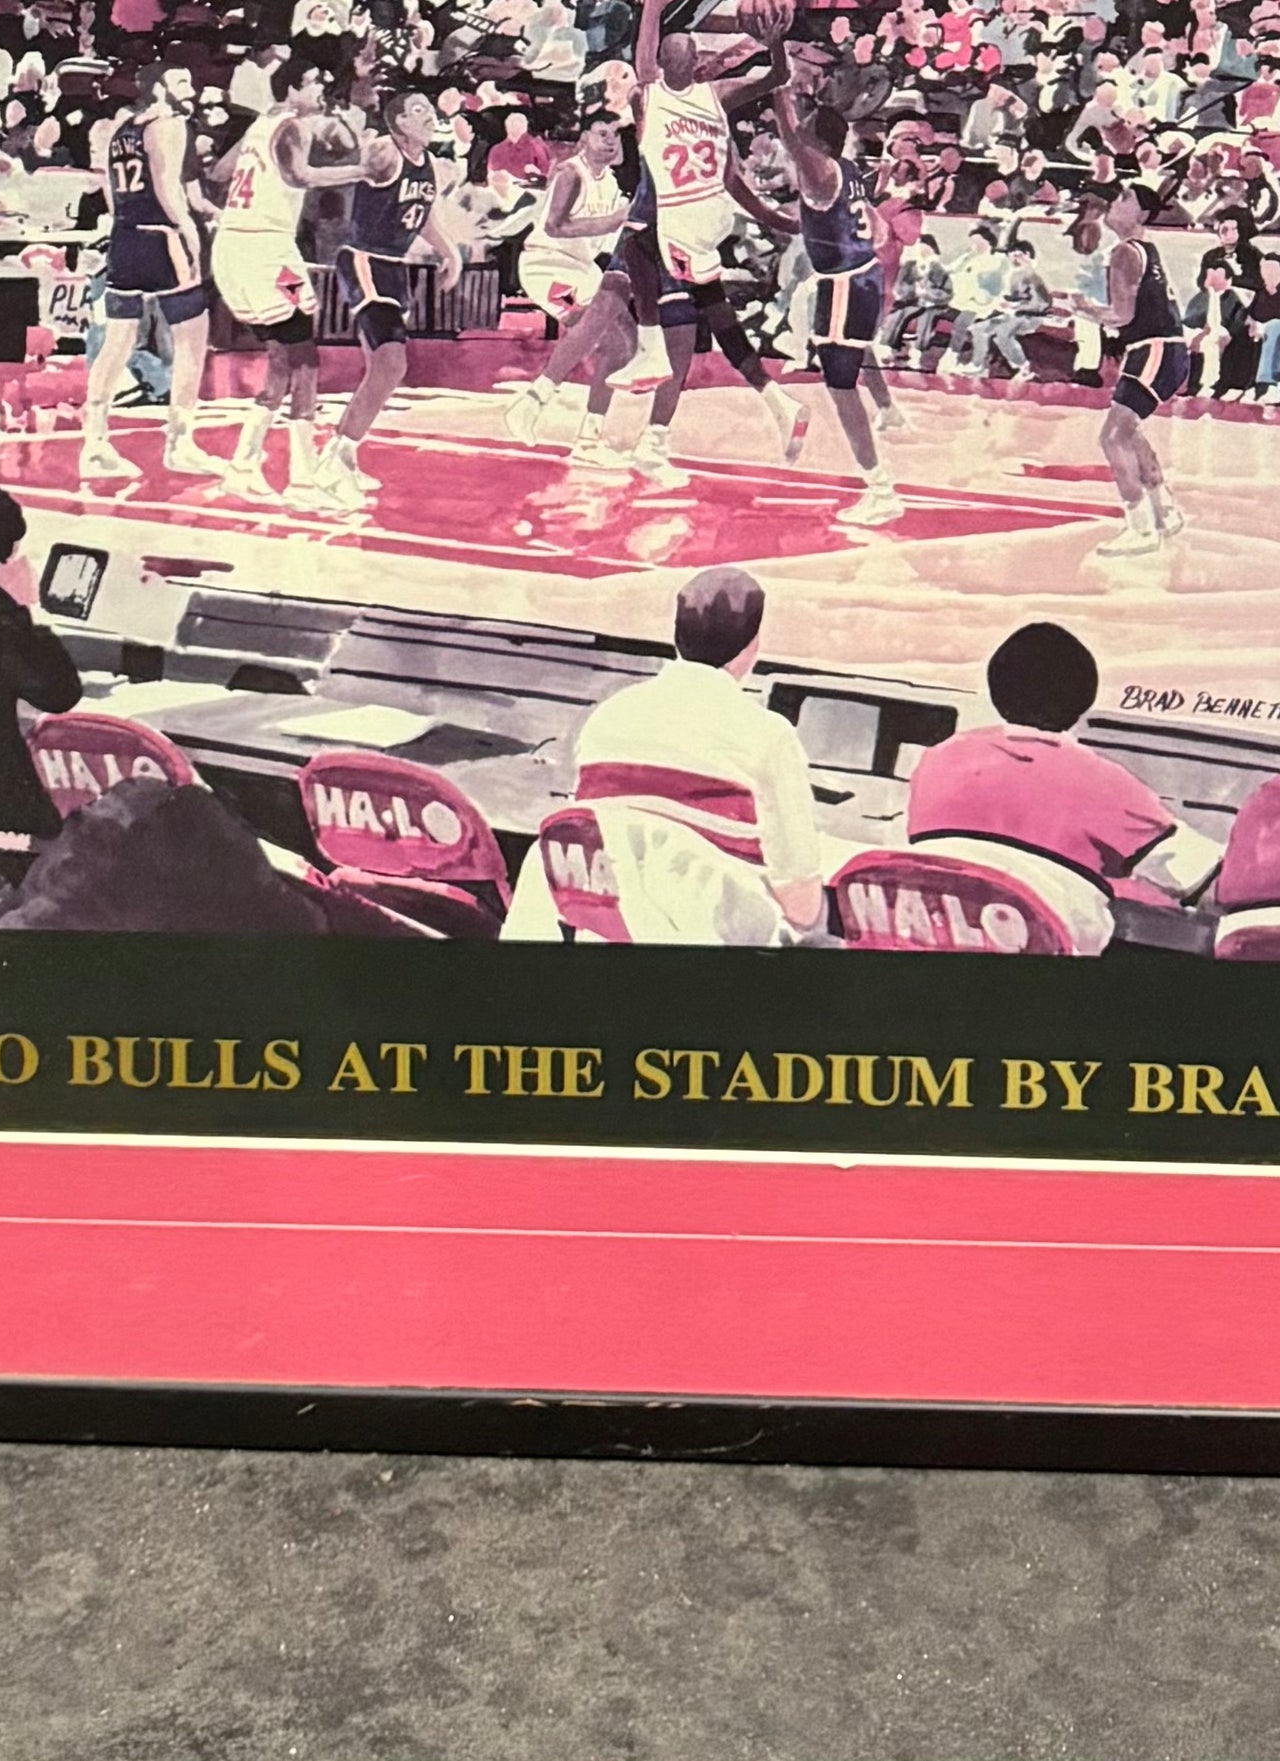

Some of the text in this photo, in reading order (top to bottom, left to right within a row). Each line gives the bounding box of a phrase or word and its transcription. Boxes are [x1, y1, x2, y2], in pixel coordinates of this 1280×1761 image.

[112, 158, 145, 192] 12
[662, 140, 718, 188] 23
[227, 166, 254, 209] 24
[1121, 685, 1185, 711] BRAD
[66, 1035, 301, 1092] BULLS
[327, 1041, 427, 1094] AT
[454, 1044, 605, 1099] THE
[634, 1049, 975, 1109] STADIUM
[1001, 1058, 1102, 1112] BY
